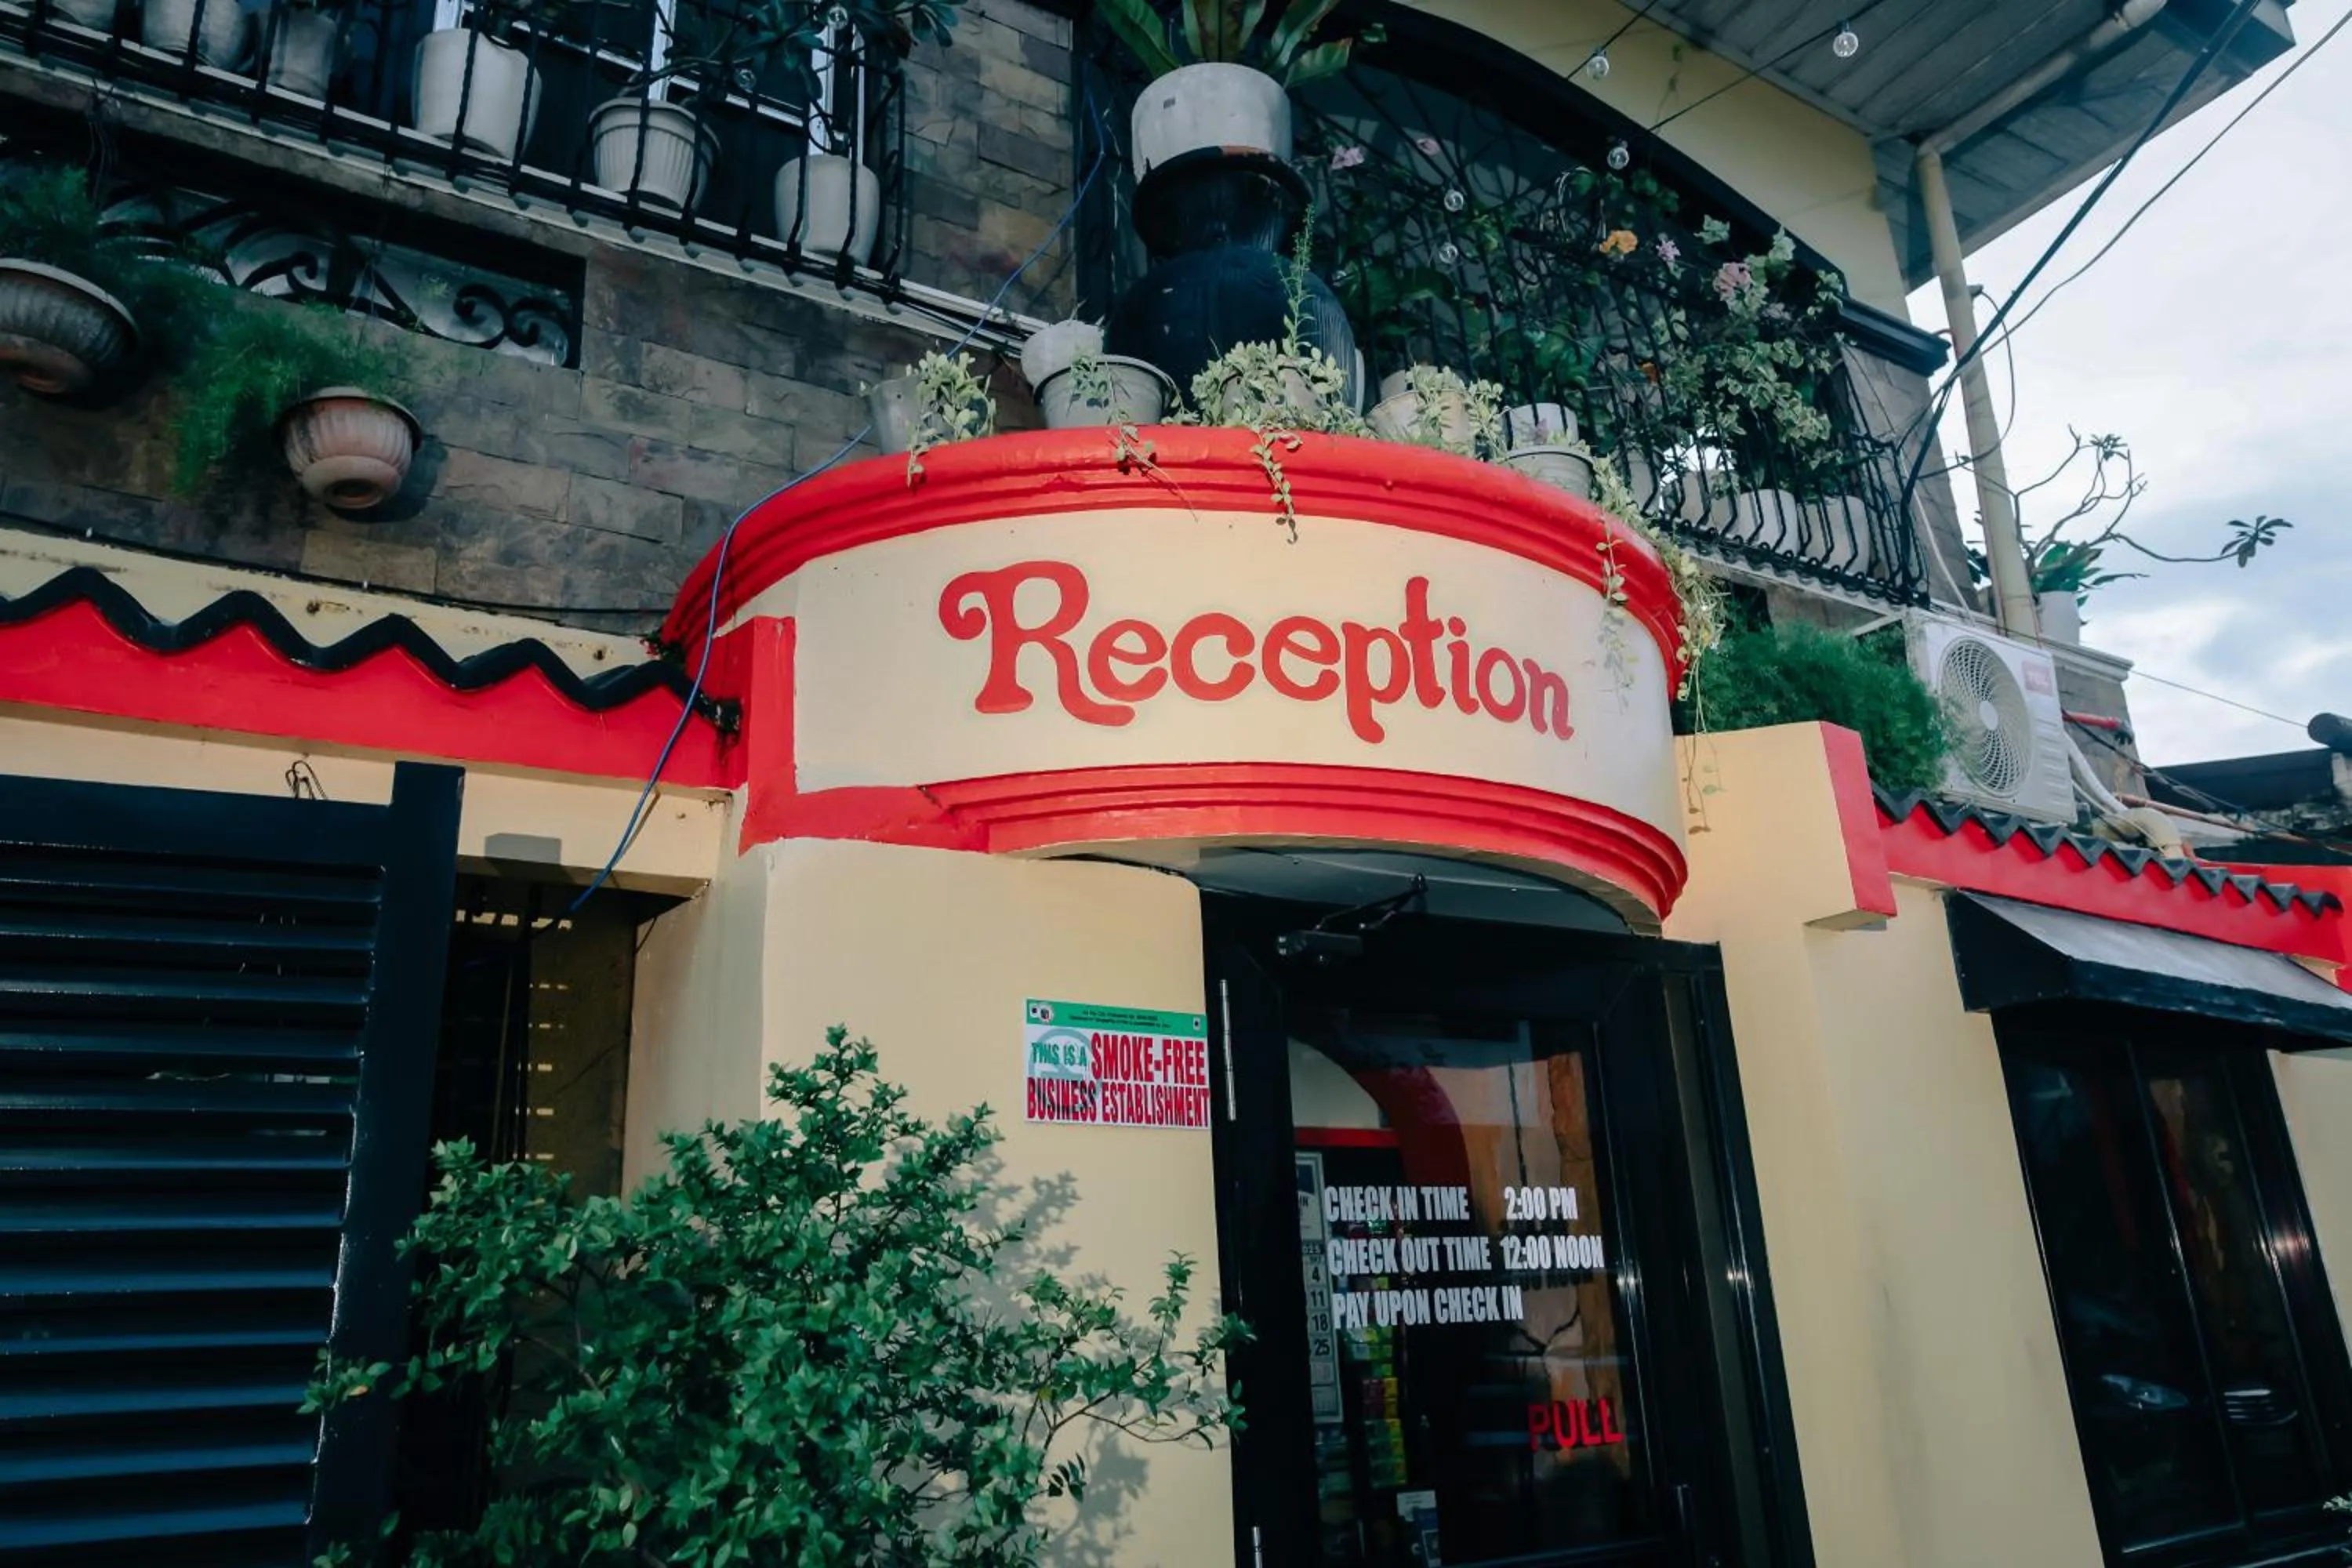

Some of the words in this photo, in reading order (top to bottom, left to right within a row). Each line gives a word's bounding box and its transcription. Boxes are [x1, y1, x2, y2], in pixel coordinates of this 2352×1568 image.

[938, 560, 1573, 743] Reception
[1032, 1042, 1059, 1065] THIS
[1064, 1044, 1077, 1066] IS
[1078, 1047, 1087, 1066] A
[1091, 1032, 1206, 1086] SMOKE-FREE
[1026, 1077, 1098, 1122] BUSINESS
[1101, 1080, 1210, 1127] ESTABLISHMENT
[1325, 1185, 1394, 1221] CHECK
[1396, 1185, 1419, 1221] IN
[1420, 1186, 1470, 1221] TIME
[1504, 1186, 1547, 1221] 2:00
[1548, 1186, 1578, 1220] PM
[1312, 1265, 1320, 1282] 4
[1327, 1239, 1399, 1275] CHECK
[1401, 1237, 1439, 1272] OUT
[1443, 1236, 1492, 1271] TIME
[1499, 1235, 1552, 1269] 12:00
[1553, 1235, 1605, 1269] NOON
[1310, 1290, 1325, 1307] 11
[1333, 1292, 1370, 1330] PAY
[1374, 1288, 1431, 1327] UPON
[1434, 1286, 1501, 1323] CHECK
[1501, 1285, 1523, 1319] IN
[1312, 1312, 1329, 1331] 18
[1314, 1338, 1330, 1356] 25
[1528, 1396, 1624, 1453] PULL
